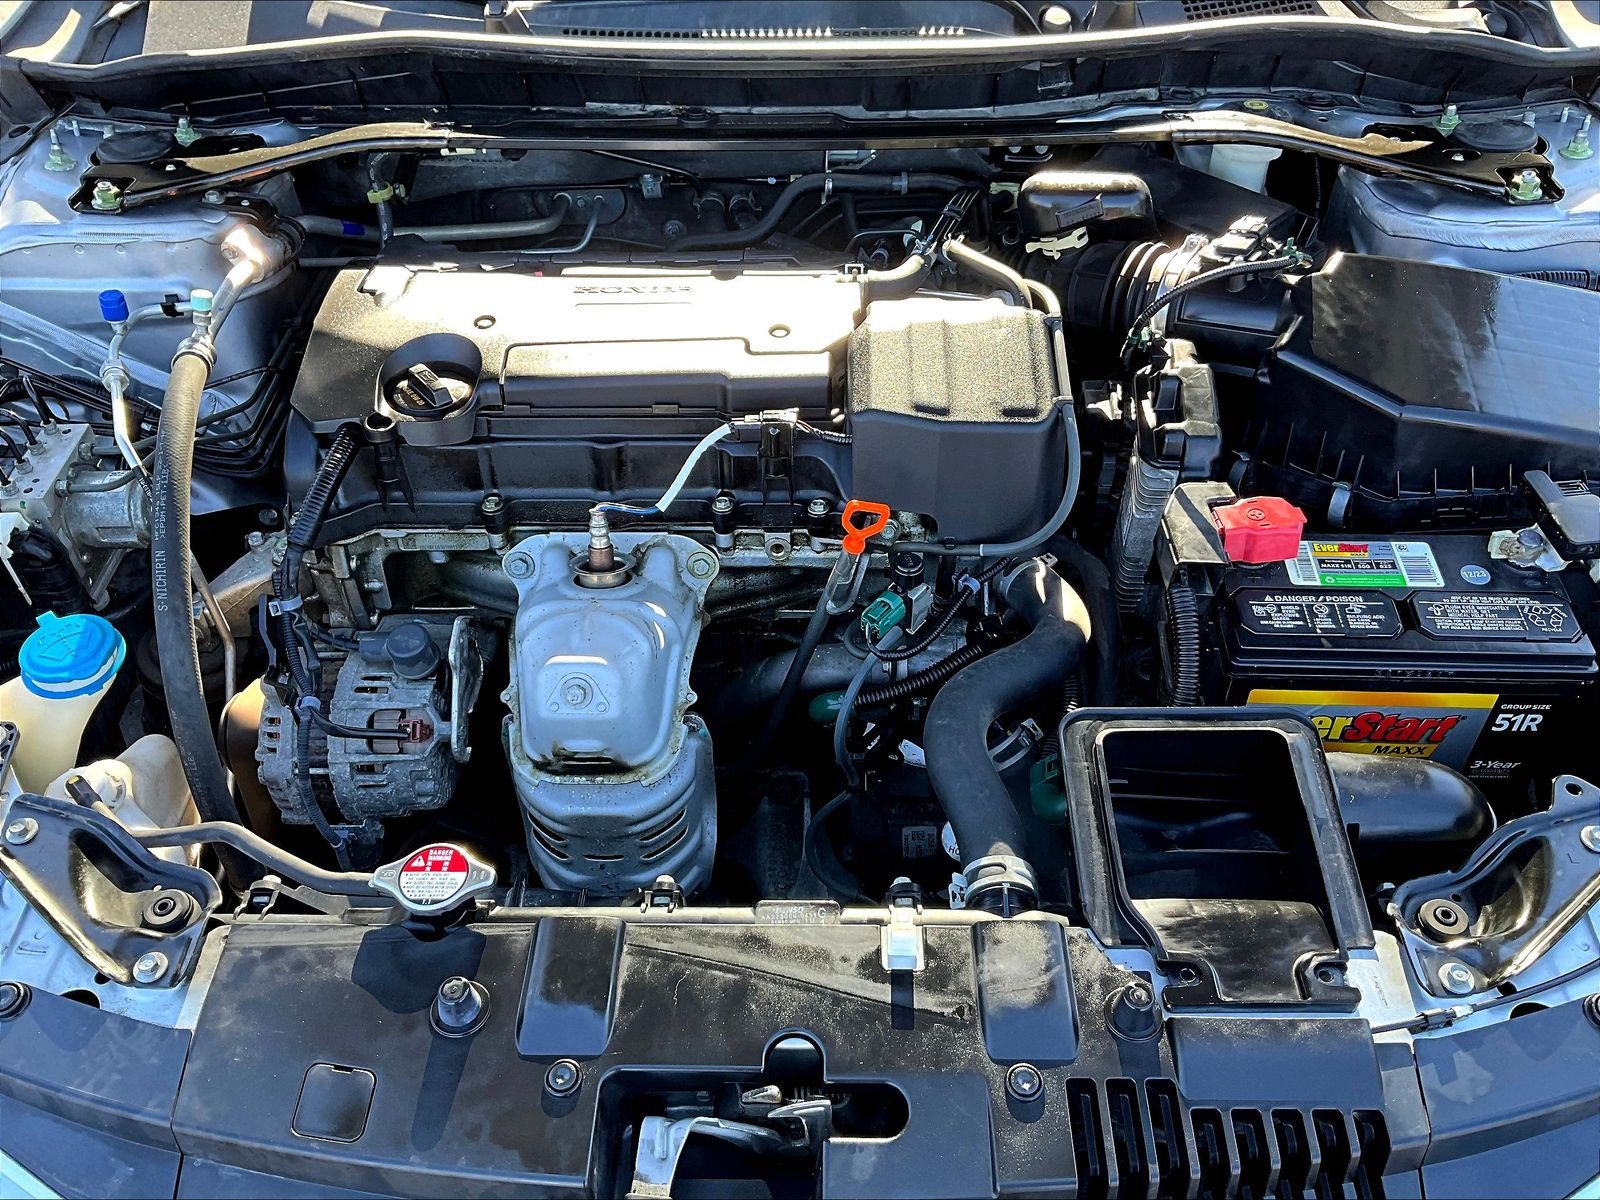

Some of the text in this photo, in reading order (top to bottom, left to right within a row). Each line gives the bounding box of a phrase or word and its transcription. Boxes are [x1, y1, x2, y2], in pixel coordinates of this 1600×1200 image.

[1312, 543, 1369, 553] EverStart
[1462, 570, 1487, 578] 12/23
[1312, 711, 1462, 743] erStart
[1491, 713, 1544, 732] 51R
[1373, 745, 1429, 755] MAXX
[1470, 760, 1522, 769] 3-Year
